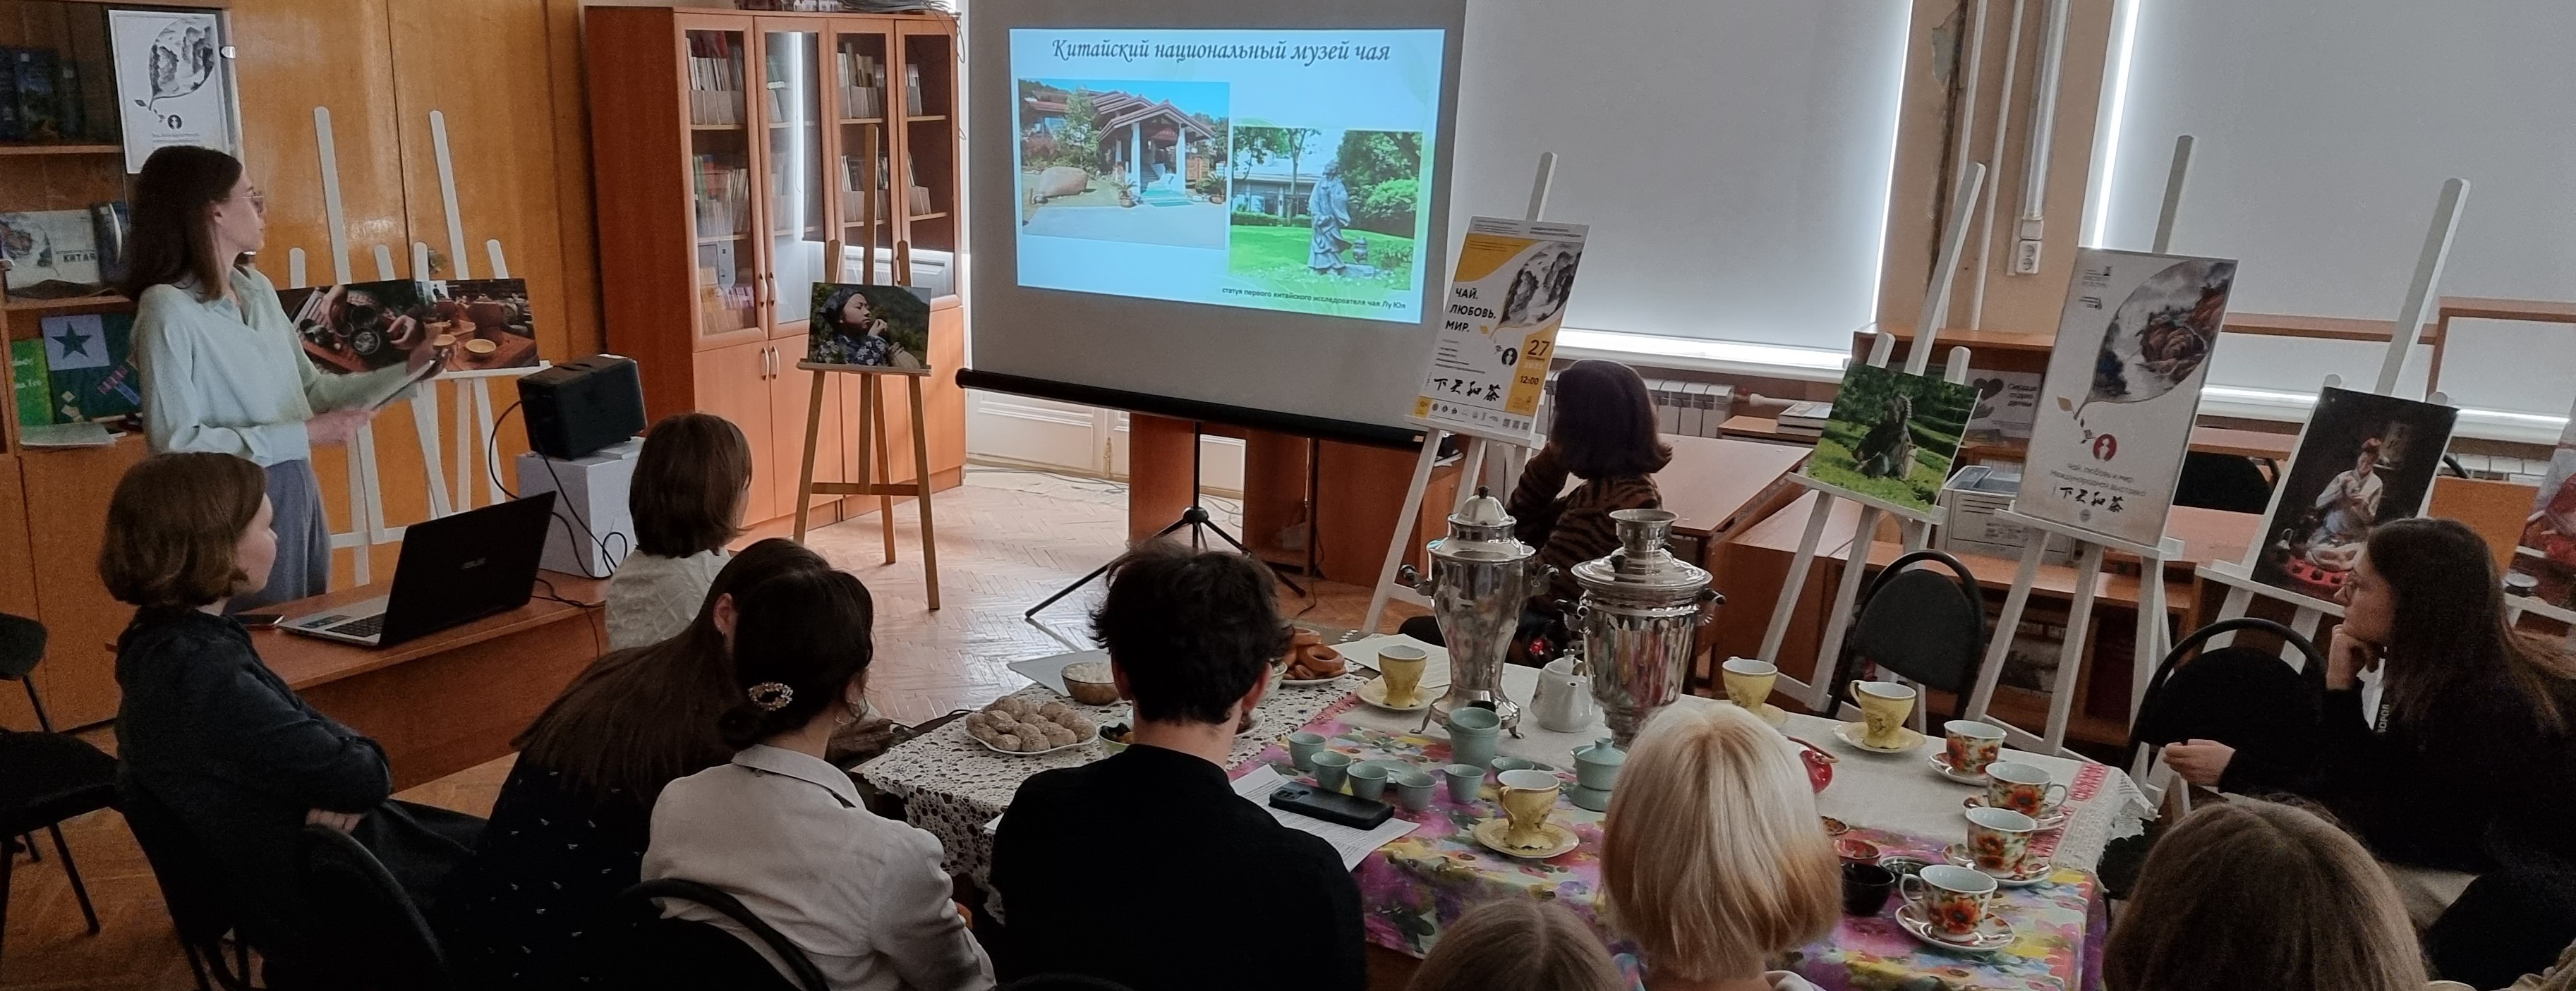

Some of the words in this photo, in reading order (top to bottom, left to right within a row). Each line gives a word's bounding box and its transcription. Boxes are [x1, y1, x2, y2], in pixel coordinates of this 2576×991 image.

[1052, 39, 1149, 63] Китайский
[1154, 39, 1287, 63] национальный
[1290, 40, 1350, 67] музей
[1354, 45, 1391, 61] чая
[1274, 292, 1312, 301] китайского
[1313, 296, 1366, 305] исследователя
[1382, 300, 1392, 309] Лу
[1456, 288, 1478, 300] ЧАЙ.
[1449, 304, 1496, 319] ЛЮБОВЬ.
[1445, 320, 1470, 332] МИР.
[1528, 339, 1551, 357] 27
[1520, 375, 1540, 385] 12:00
